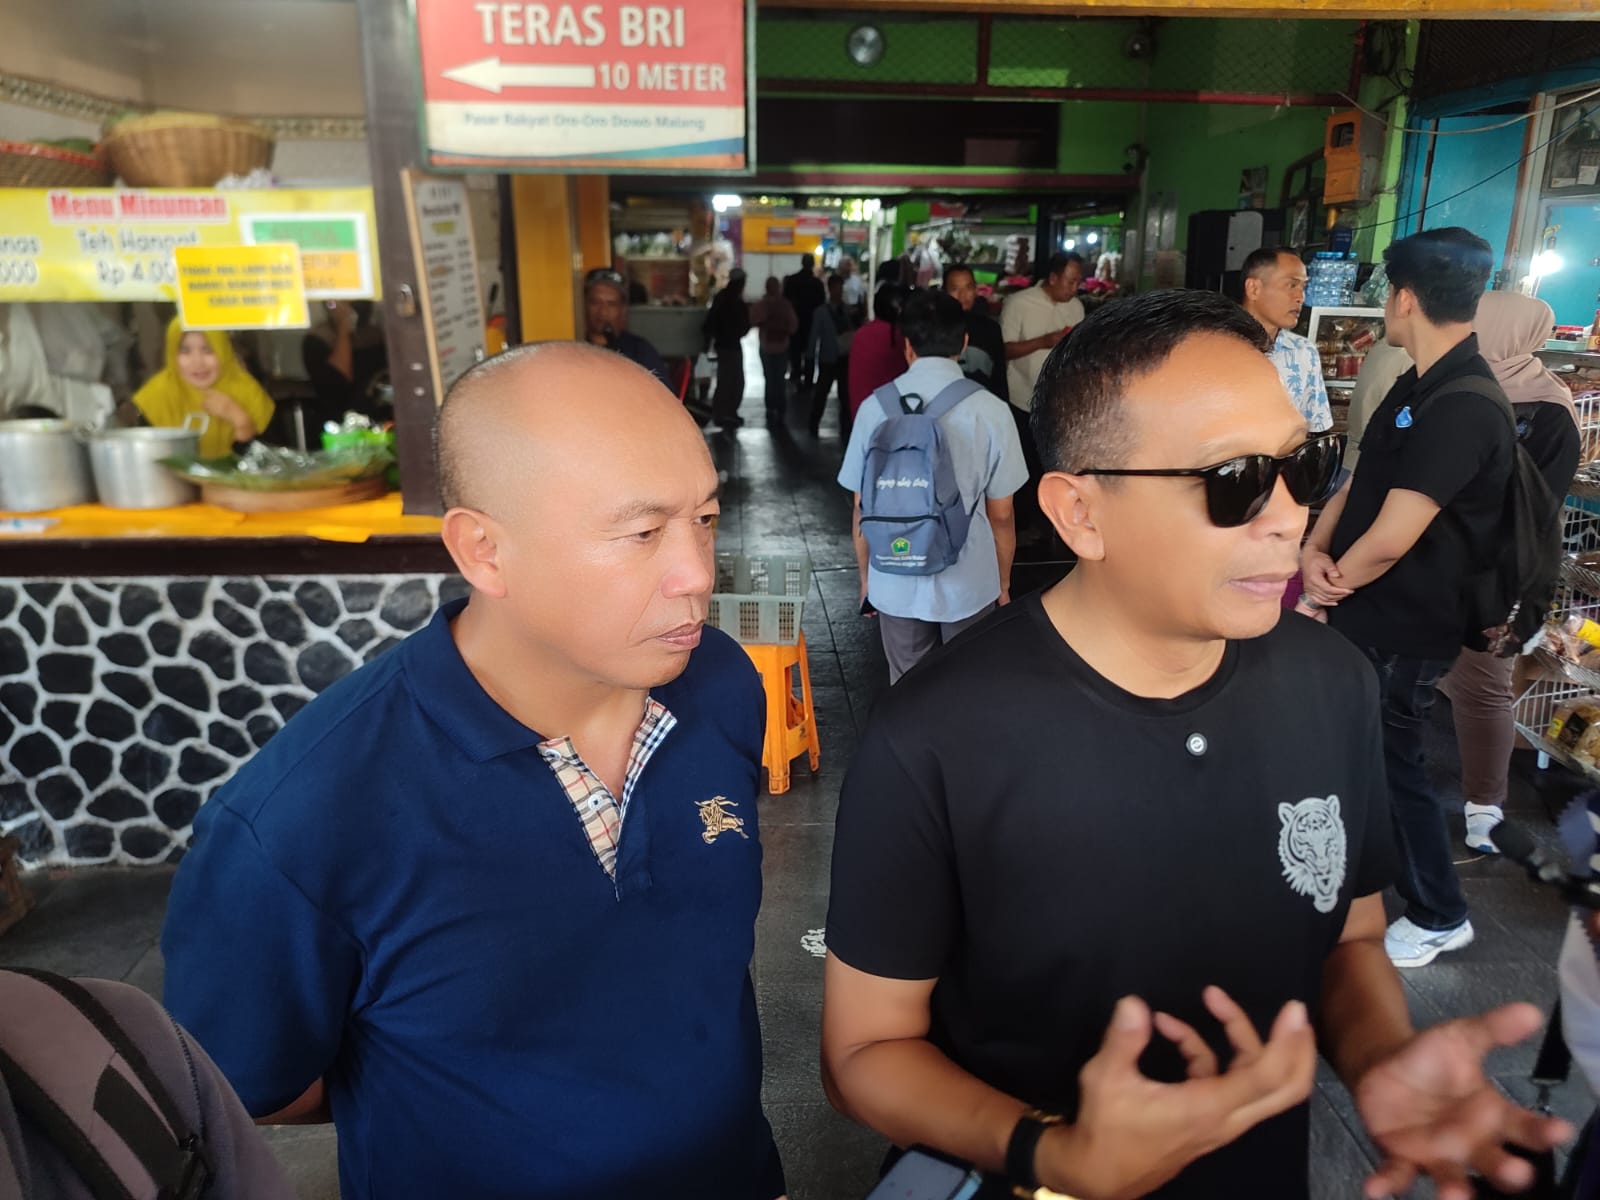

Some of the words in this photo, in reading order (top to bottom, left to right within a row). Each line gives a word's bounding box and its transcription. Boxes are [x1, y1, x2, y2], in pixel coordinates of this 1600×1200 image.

[474, 3, 605, 46] TERAS
[619, 5, 685, 48] BRI
[598, 62, 630, 91] 10
[638, 63, 727, 92] METER
[51, 194, 114, 218] Menu
[119, 194, 226, 217] Minuman
[0, 236, 40, 254] nas
[79, 230, 114, 249] Teh
[97, 258, 126, 287] Rp
